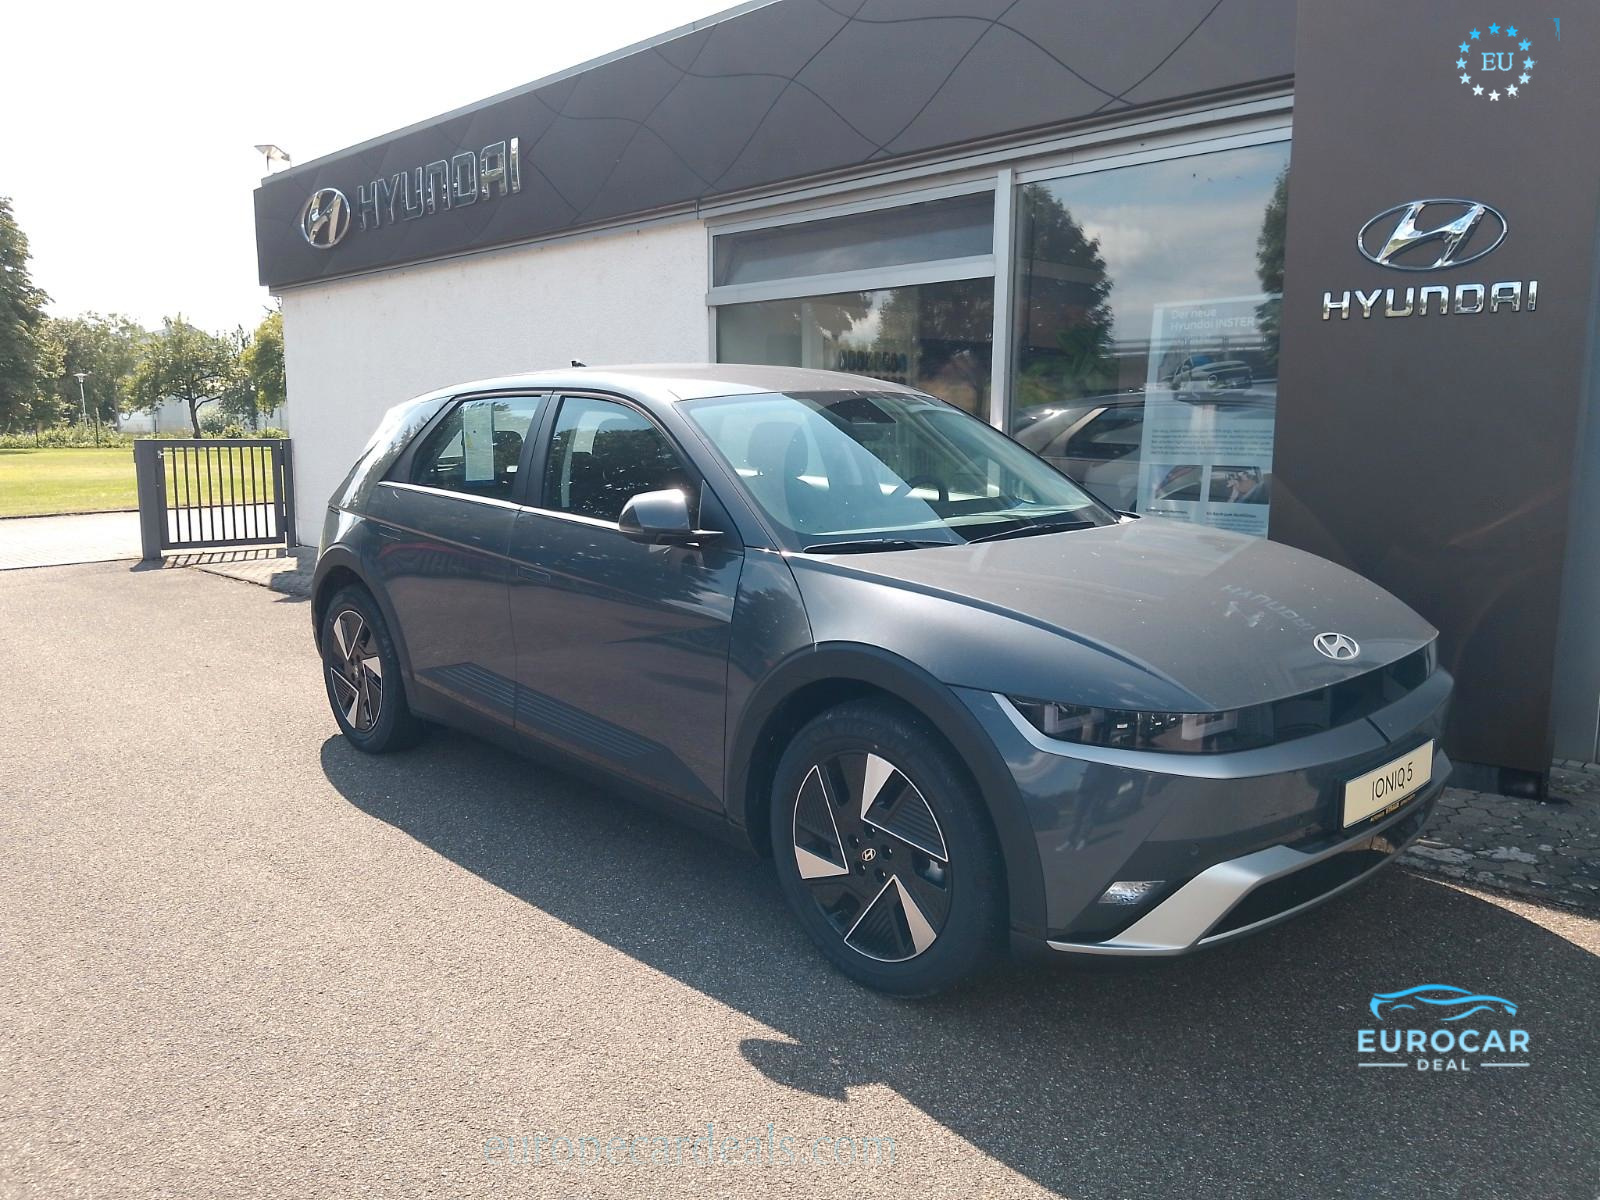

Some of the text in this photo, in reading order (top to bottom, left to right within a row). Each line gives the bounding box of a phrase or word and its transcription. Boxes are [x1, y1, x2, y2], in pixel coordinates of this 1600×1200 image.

[357, 136, 521, 231] HYUNDAI
[1171, 309, 1217, 319] Der neue
[1322, 280, 1538, 320] HYUNDAI
[1170, 316, 1255, 333] Hyundai INSTER
[1371, 761, 1413, 801] IONIQ 5
